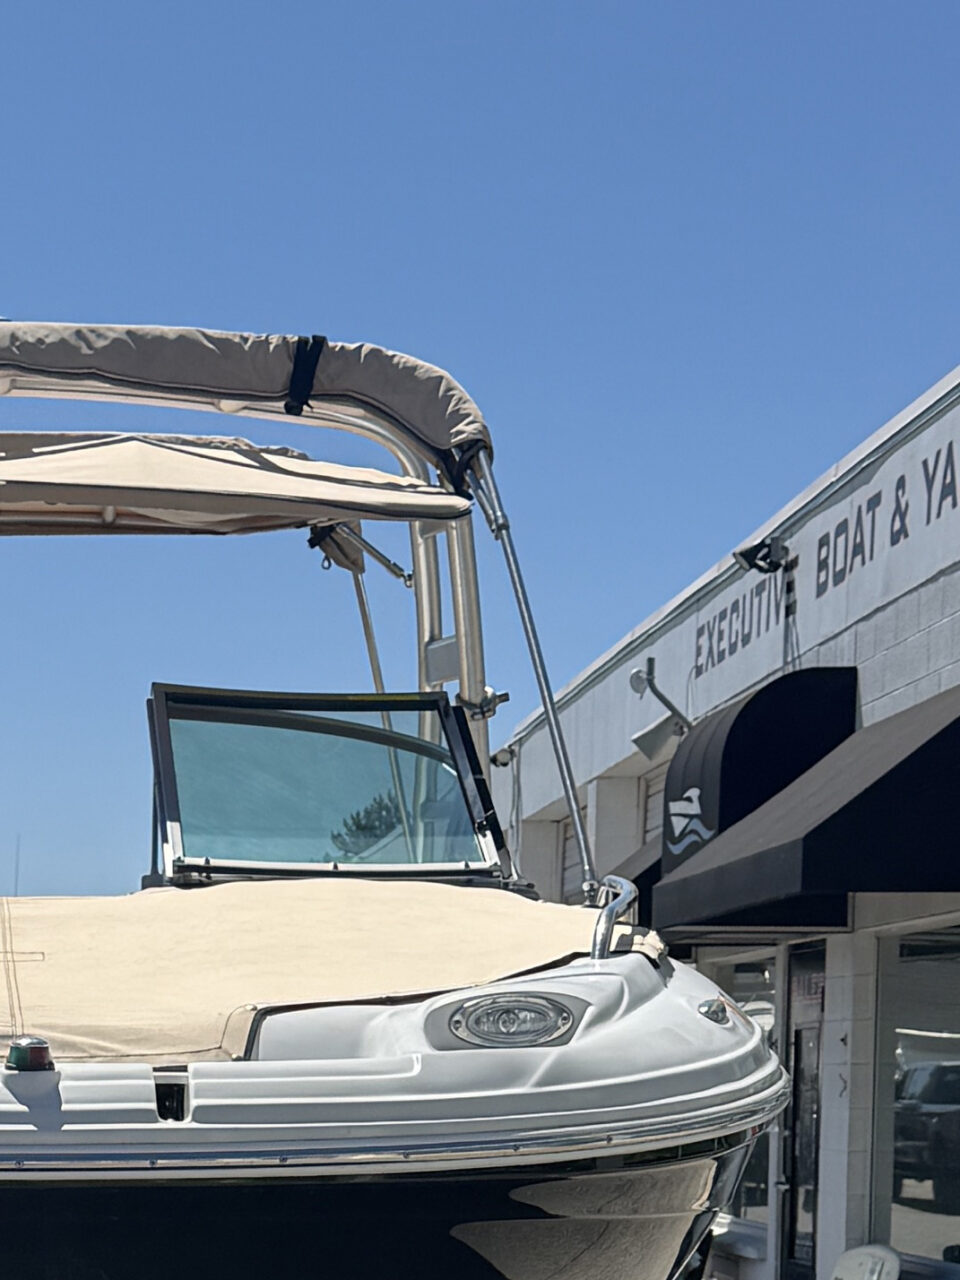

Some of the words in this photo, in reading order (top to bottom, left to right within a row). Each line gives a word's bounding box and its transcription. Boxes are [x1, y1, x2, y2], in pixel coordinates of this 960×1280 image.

[695, 573, 792, 680] EXECUTIV
[816, 490, 883, 599] BOAT
[890, 474, 910, 548] &
